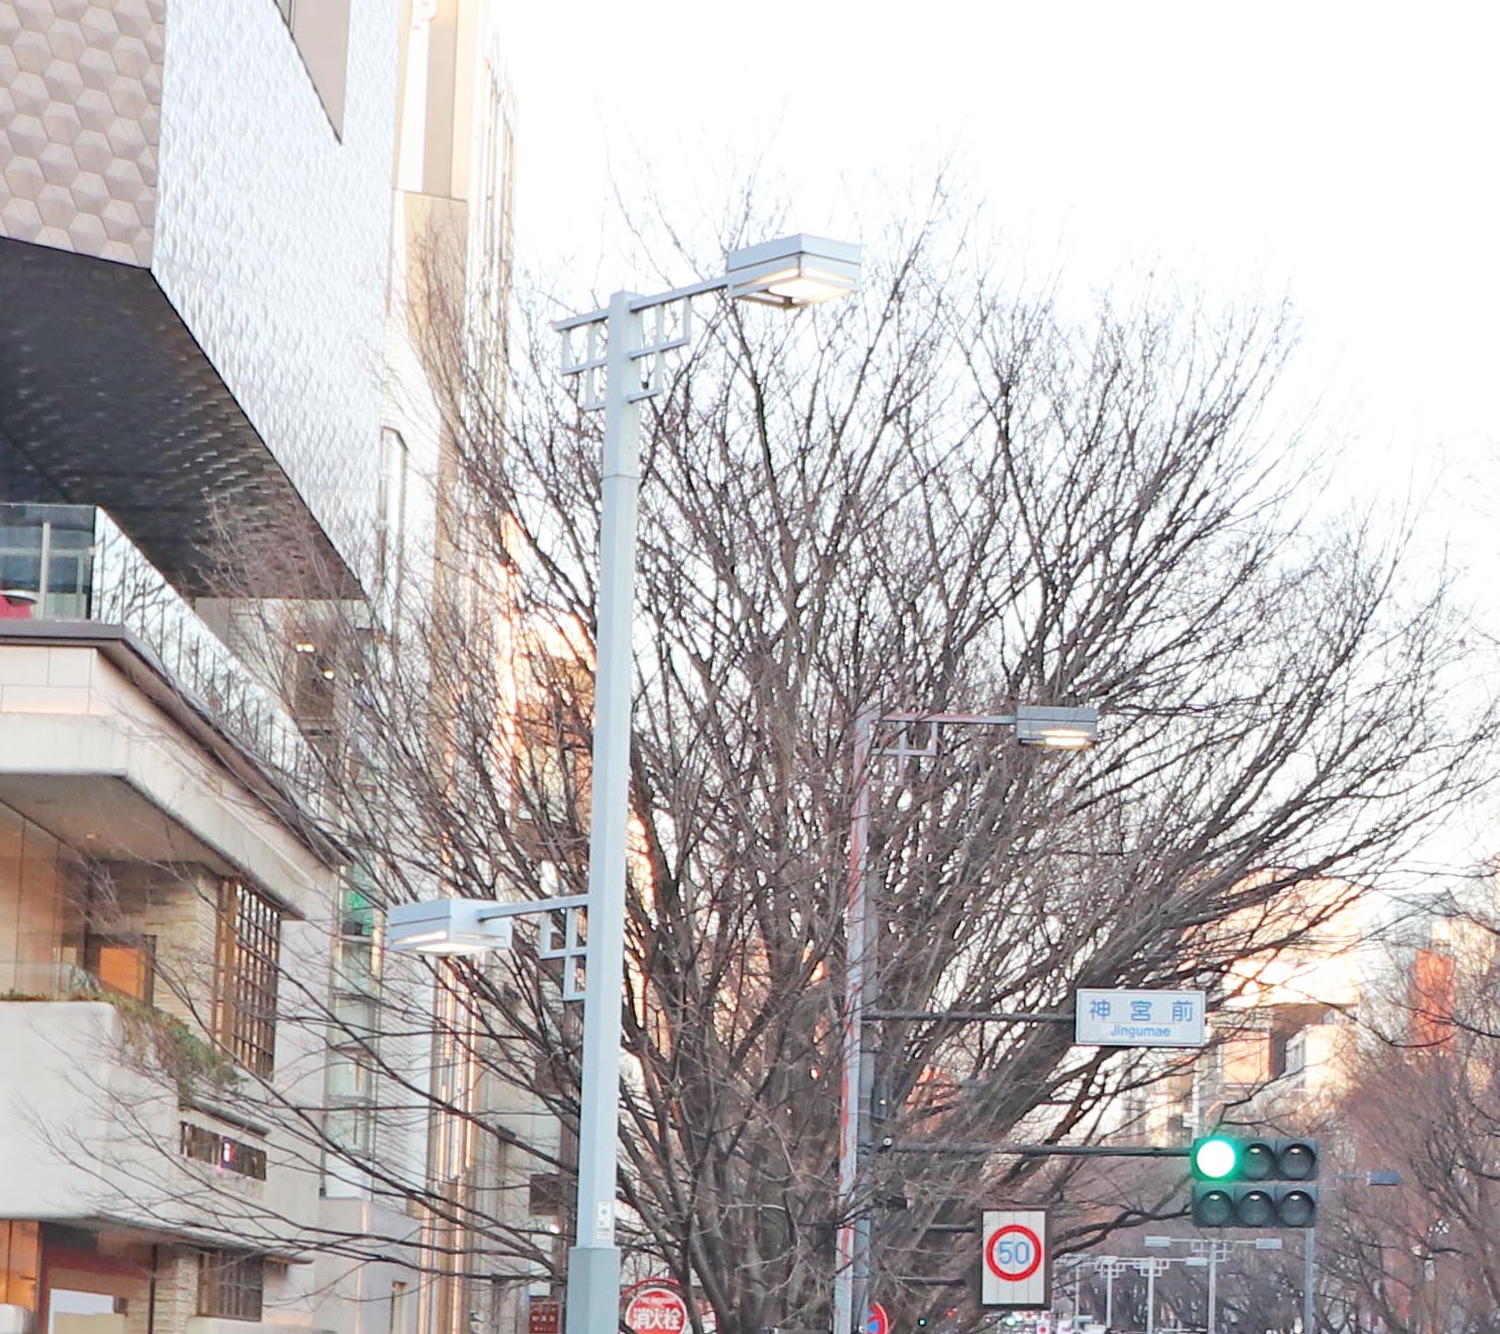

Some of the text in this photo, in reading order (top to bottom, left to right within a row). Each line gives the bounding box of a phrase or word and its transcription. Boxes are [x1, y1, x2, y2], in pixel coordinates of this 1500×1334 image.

[1090, 999, 1194, 1022] 神宮前
[1111, 1024, 1172, 1039] Jingumae
[999, 1241, 1031, 1265] 50
[633, 1307, 682, 1330] 消火栓
